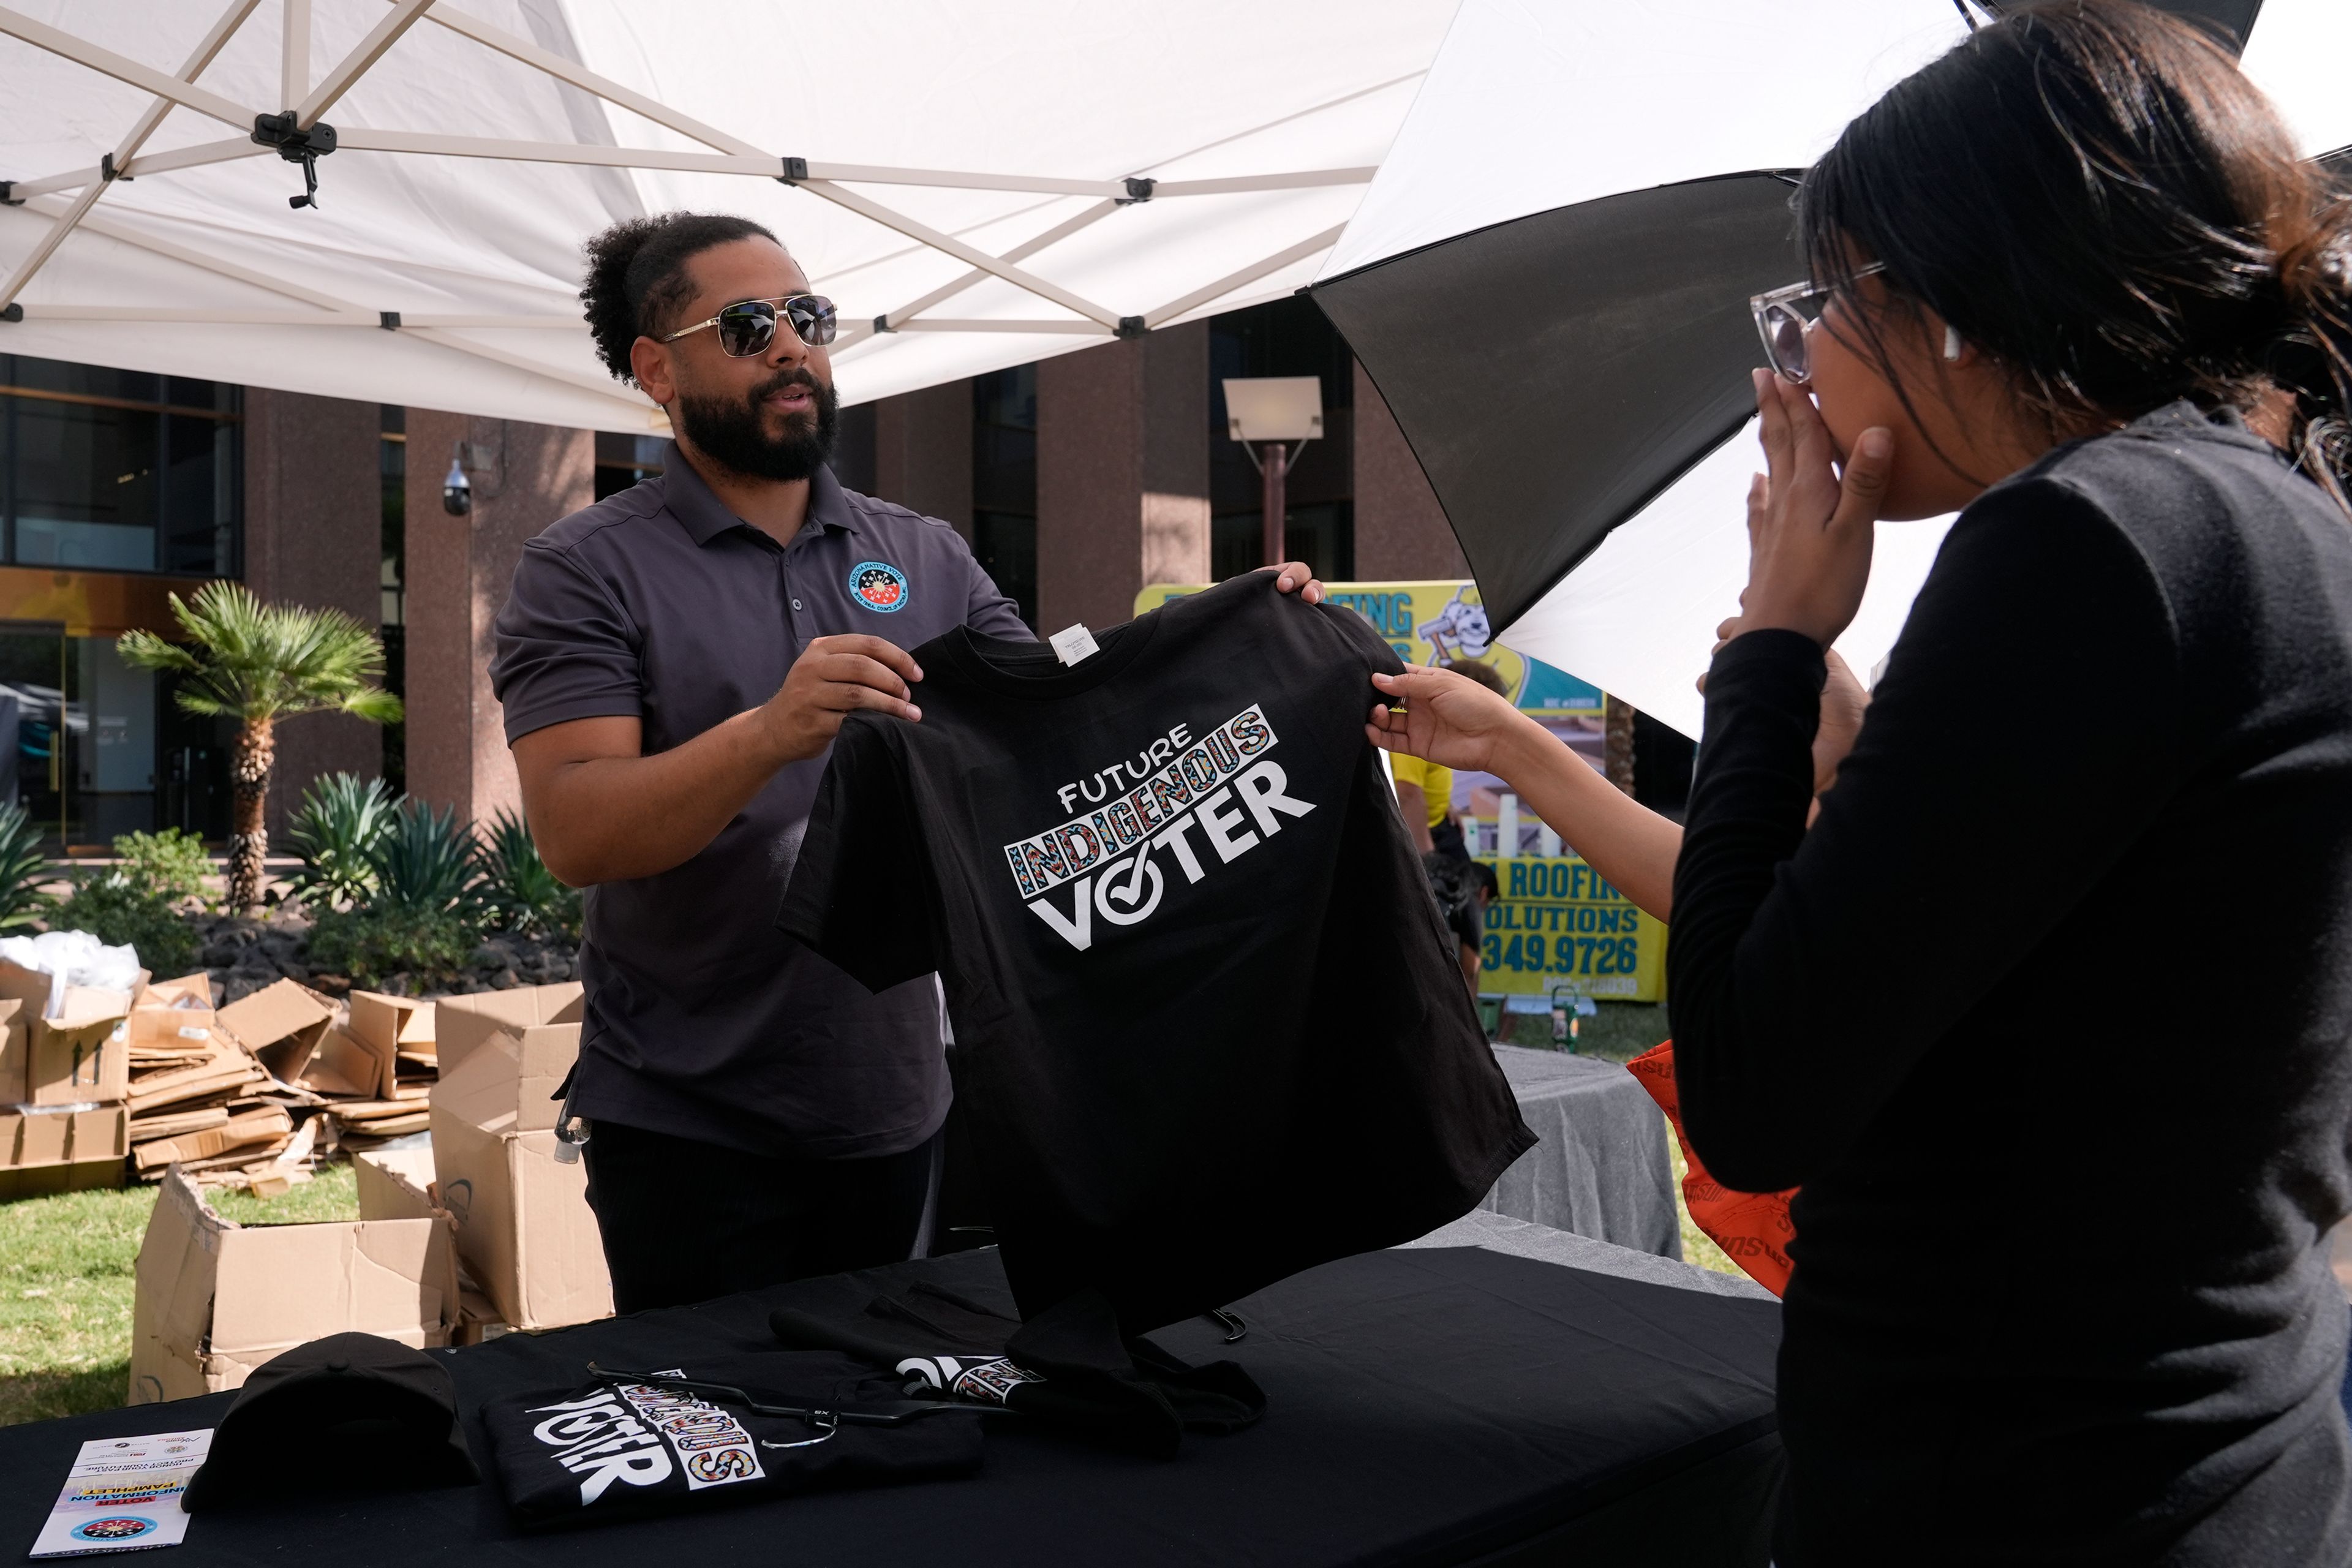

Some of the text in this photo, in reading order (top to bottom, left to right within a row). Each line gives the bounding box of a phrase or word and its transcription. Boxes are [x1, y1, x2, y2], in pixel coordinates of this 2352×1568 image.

[851, 565, 865, 587] ARIZONA
[889, 568, 903, 581] VOTE
[1057, 722, 1192, 814] FUTURE
[1008, 710, 1270, 896] INDIGENOUS
[1027, 760, 1317, 952] VOTER
[72, 1487, 184, 1501] INFORMATION
[86, 1483, 175, 1495] PAMPHLET
[98, 1497, 154, 1506] VOTER
